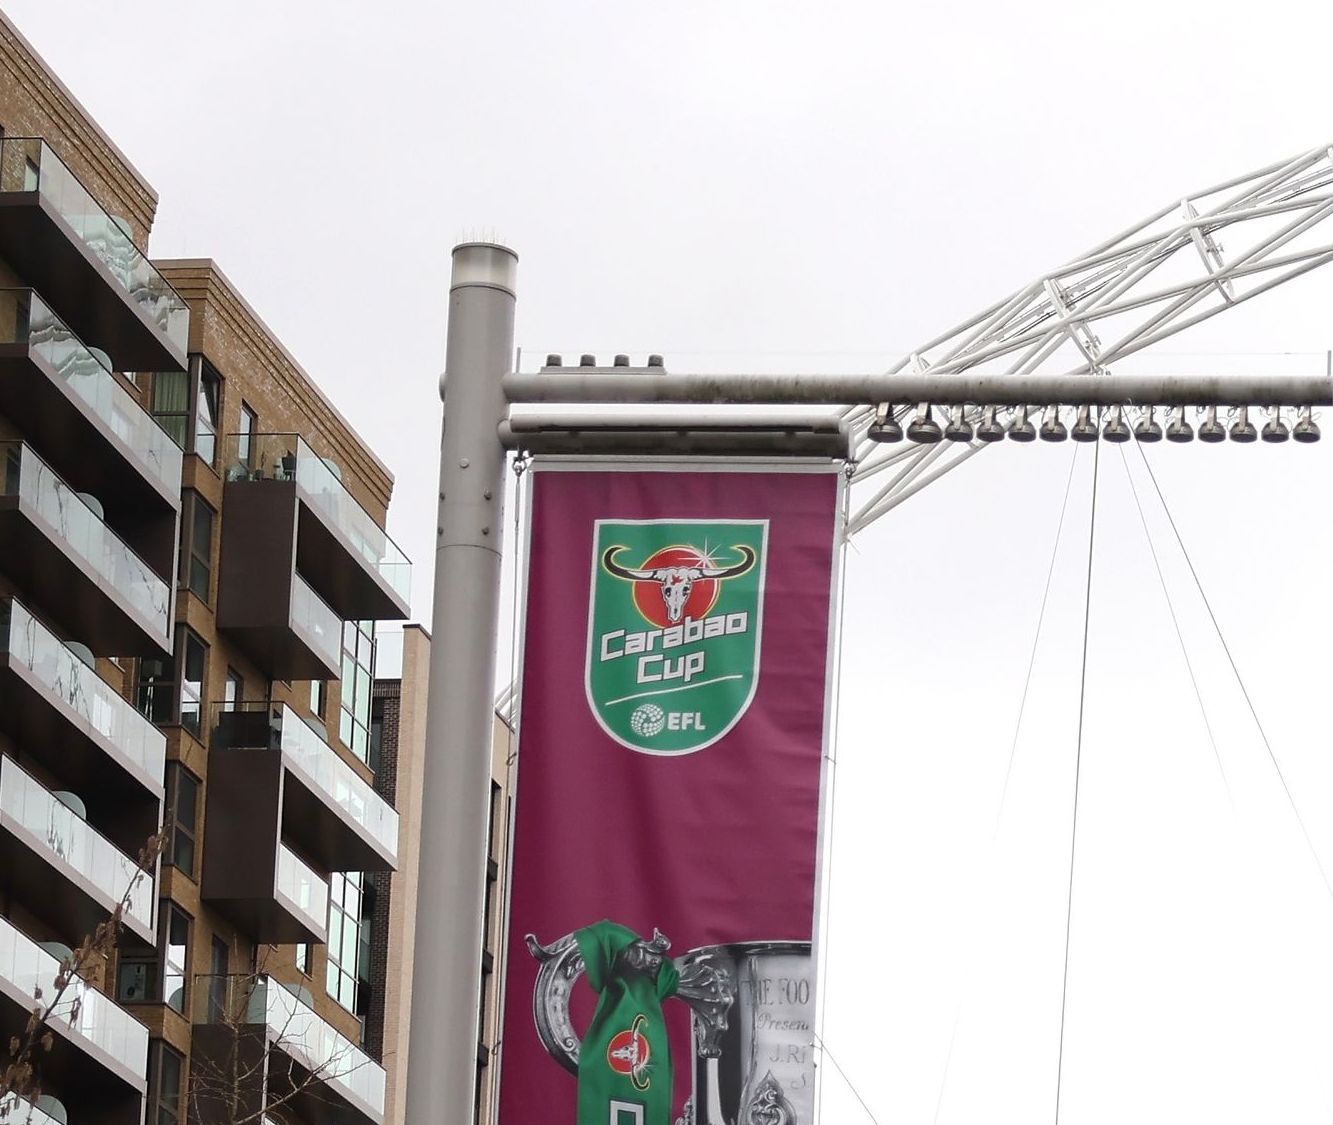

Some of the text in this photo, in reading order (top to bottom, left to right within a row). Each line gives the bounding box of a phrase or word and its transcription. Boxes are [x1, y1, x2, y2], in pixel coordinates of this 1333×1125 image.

[601, 612, 748, 662] Carabao
[637, 651, 705, 684] Cup
[667, 712, 706, 730] EFL
